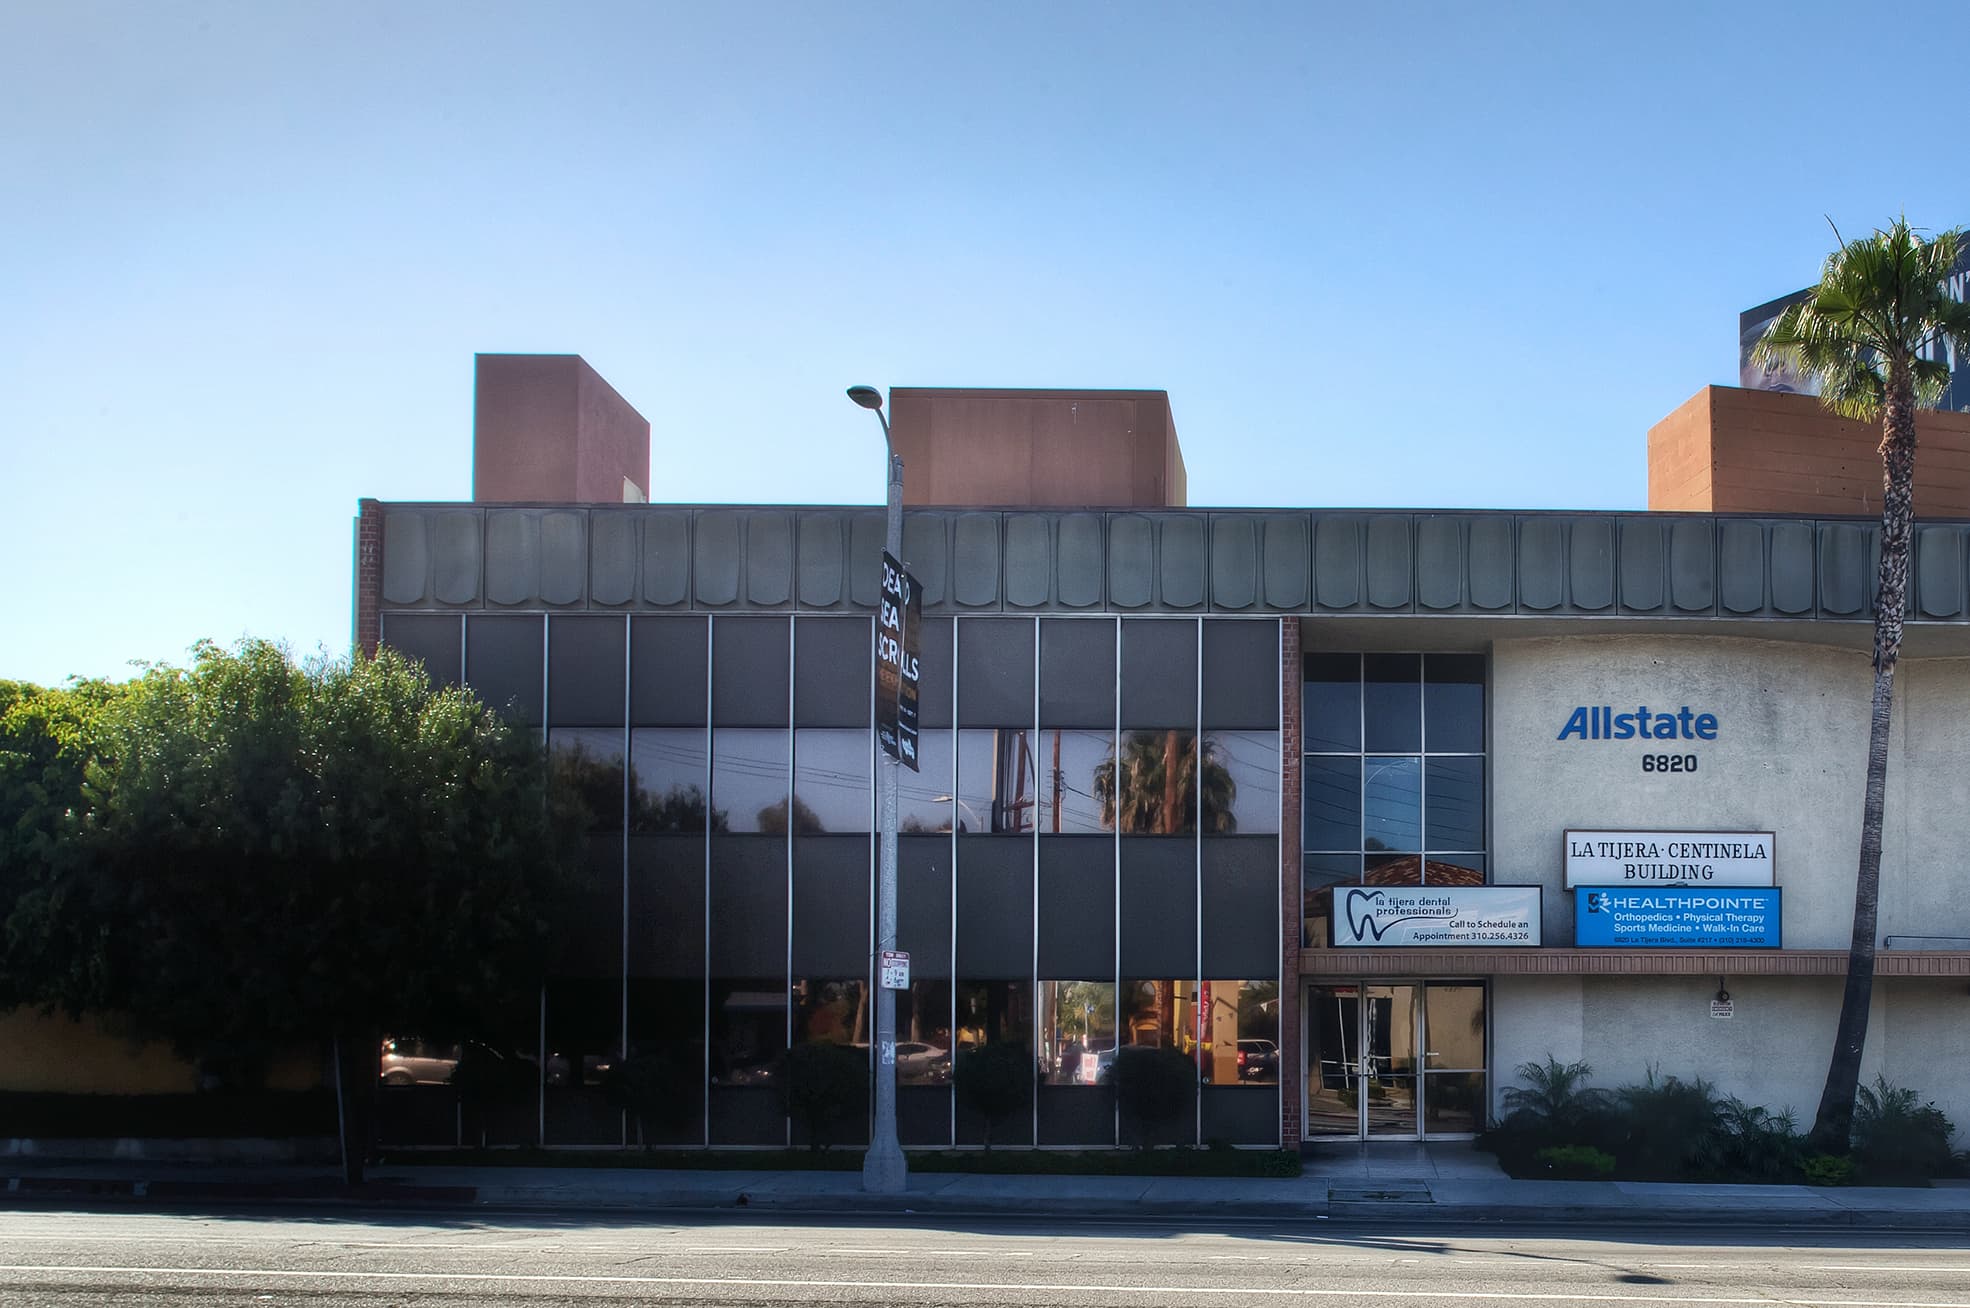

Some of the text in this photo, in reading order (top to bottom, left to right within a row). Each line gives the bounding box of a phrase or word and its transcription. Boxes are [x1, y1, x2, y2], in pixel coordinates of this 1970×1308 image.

[878, 632, 920, 681] SCRLLS
[1556, 706, 1719, 740] Allstate
[1642, 754, 1698, 773] 6820
[1571, 842, 1595, 858] LA
[1624, 864, 1714, 880] BUILDING
[1375, 896, 1451, 908] la tijera dental
[1614, 898, 1765, 910] HEALTHPOINTE
[1376, 906, 1451, 917] professionals
[1614, 912, 1765, 924] Orthopedics Physical Therapy
[1449, 920, 1466, 929] Call
[1466, 921, 1476, 929] to
[1477, 920, 1517, 929] Schedule
[1614, 923, 1765, 934] Sports Medicine Walk-In Care
[1412, 932, 1470, 942] Appointment
